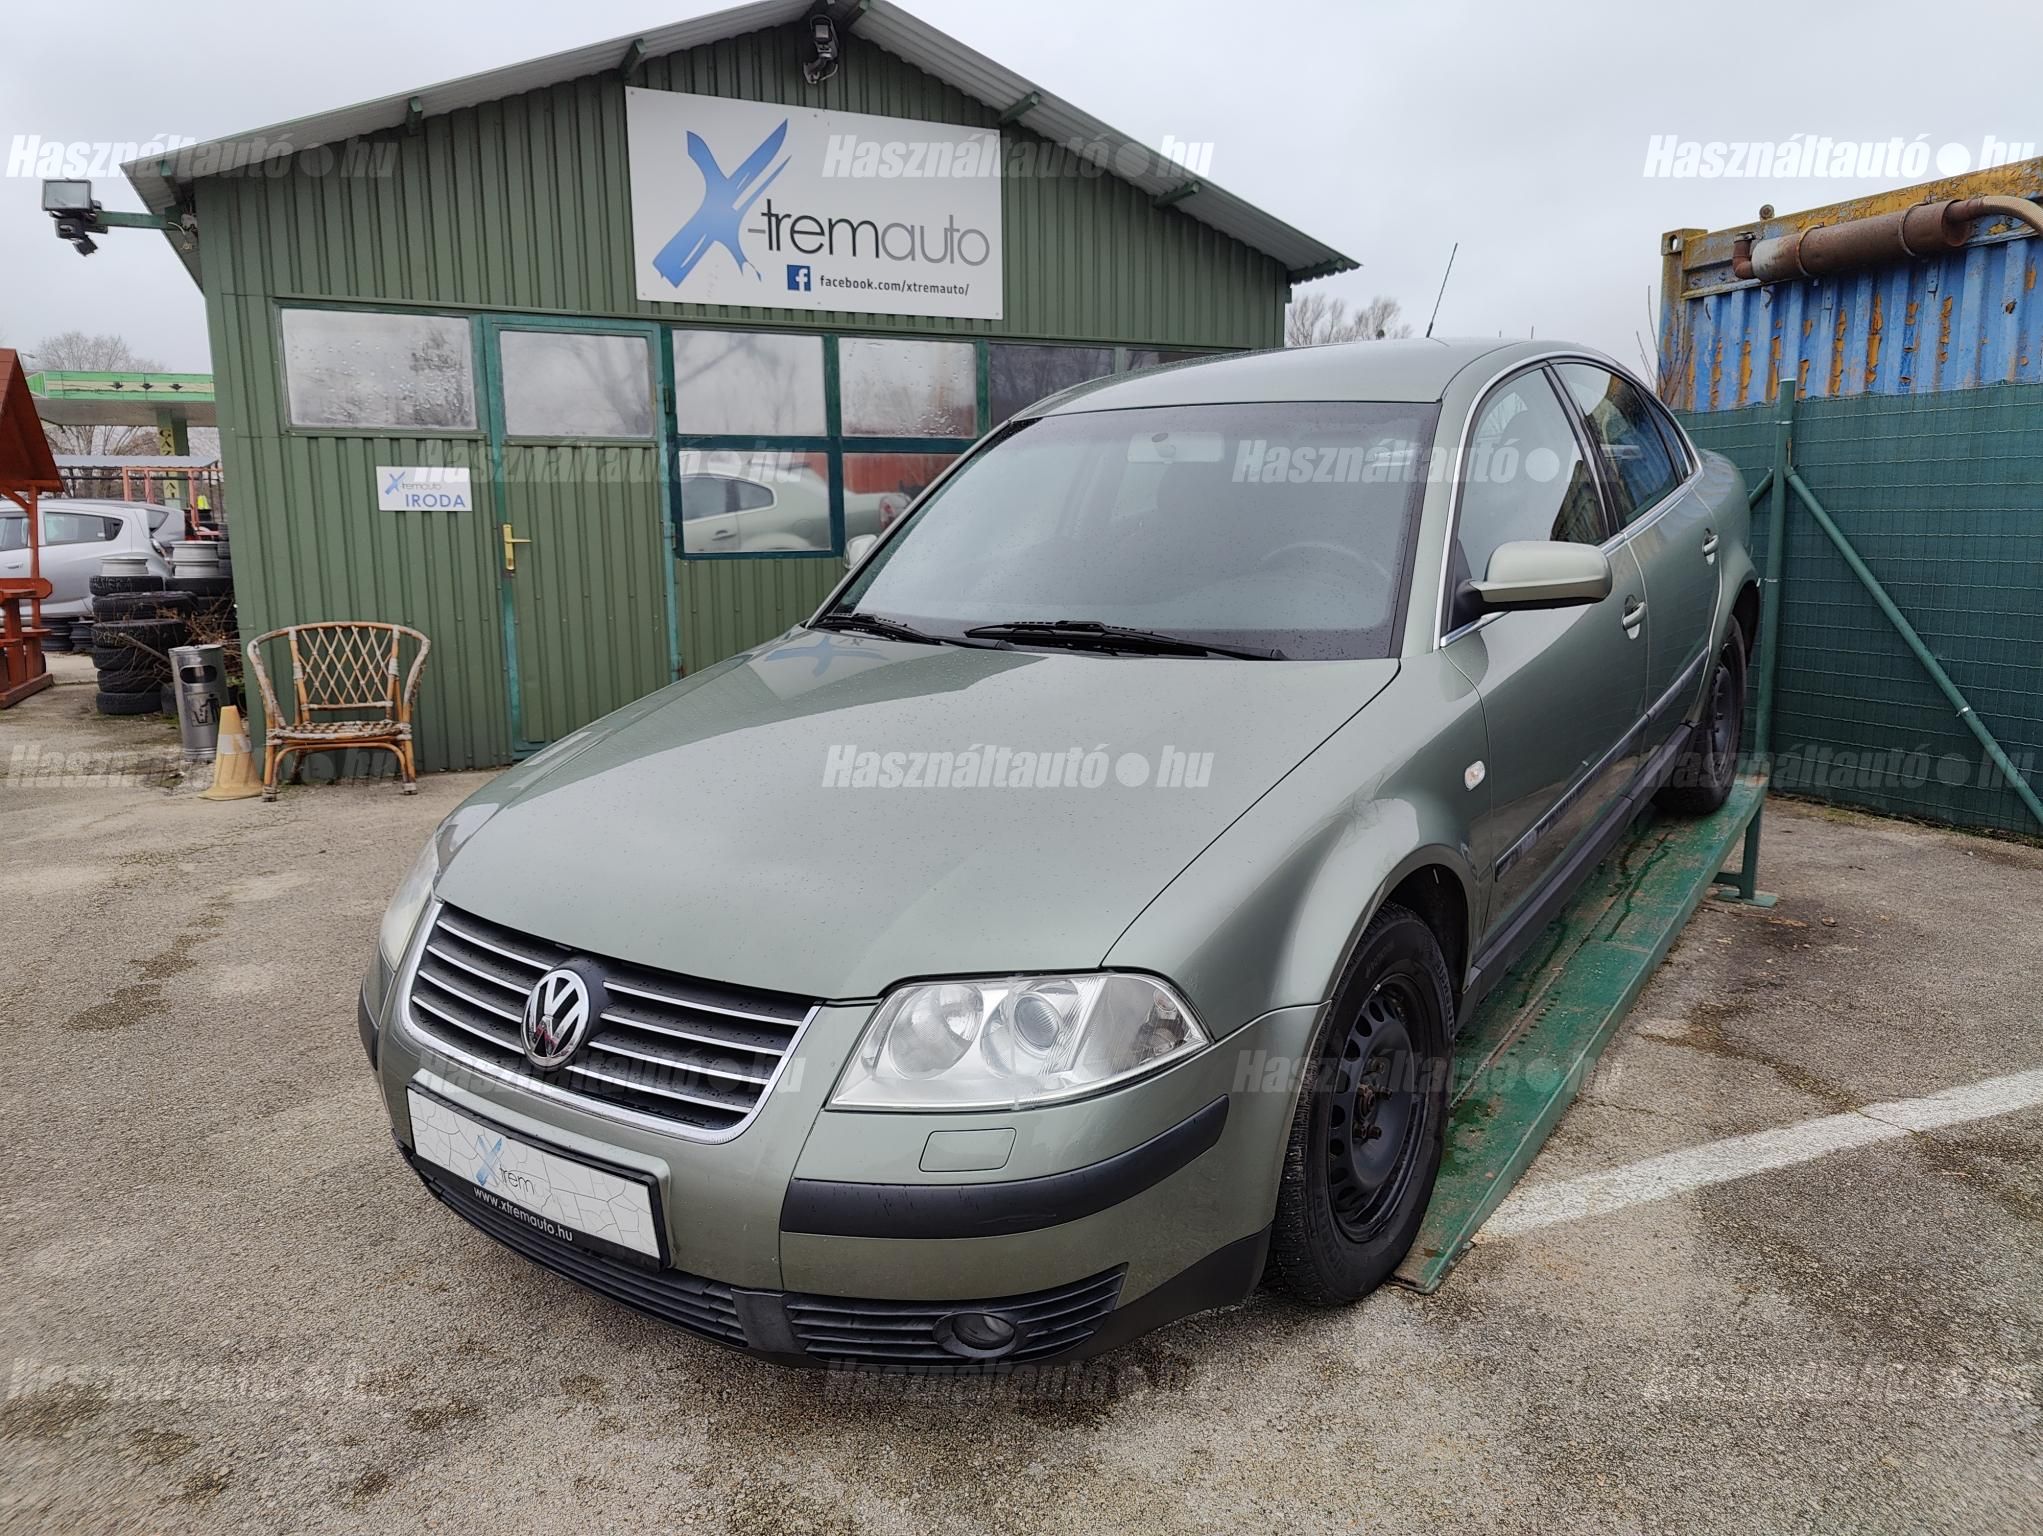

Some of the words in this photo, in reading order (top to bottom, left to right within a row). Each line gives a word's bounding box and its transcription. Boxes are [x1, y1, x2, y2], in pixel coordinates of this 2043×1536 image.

[820, 276, 970, 296] facebook.com/xtremauto/
[405, 494, 466, 508] IRODA
[473, 1186, 573, 1242] www.xtremauto.hu
